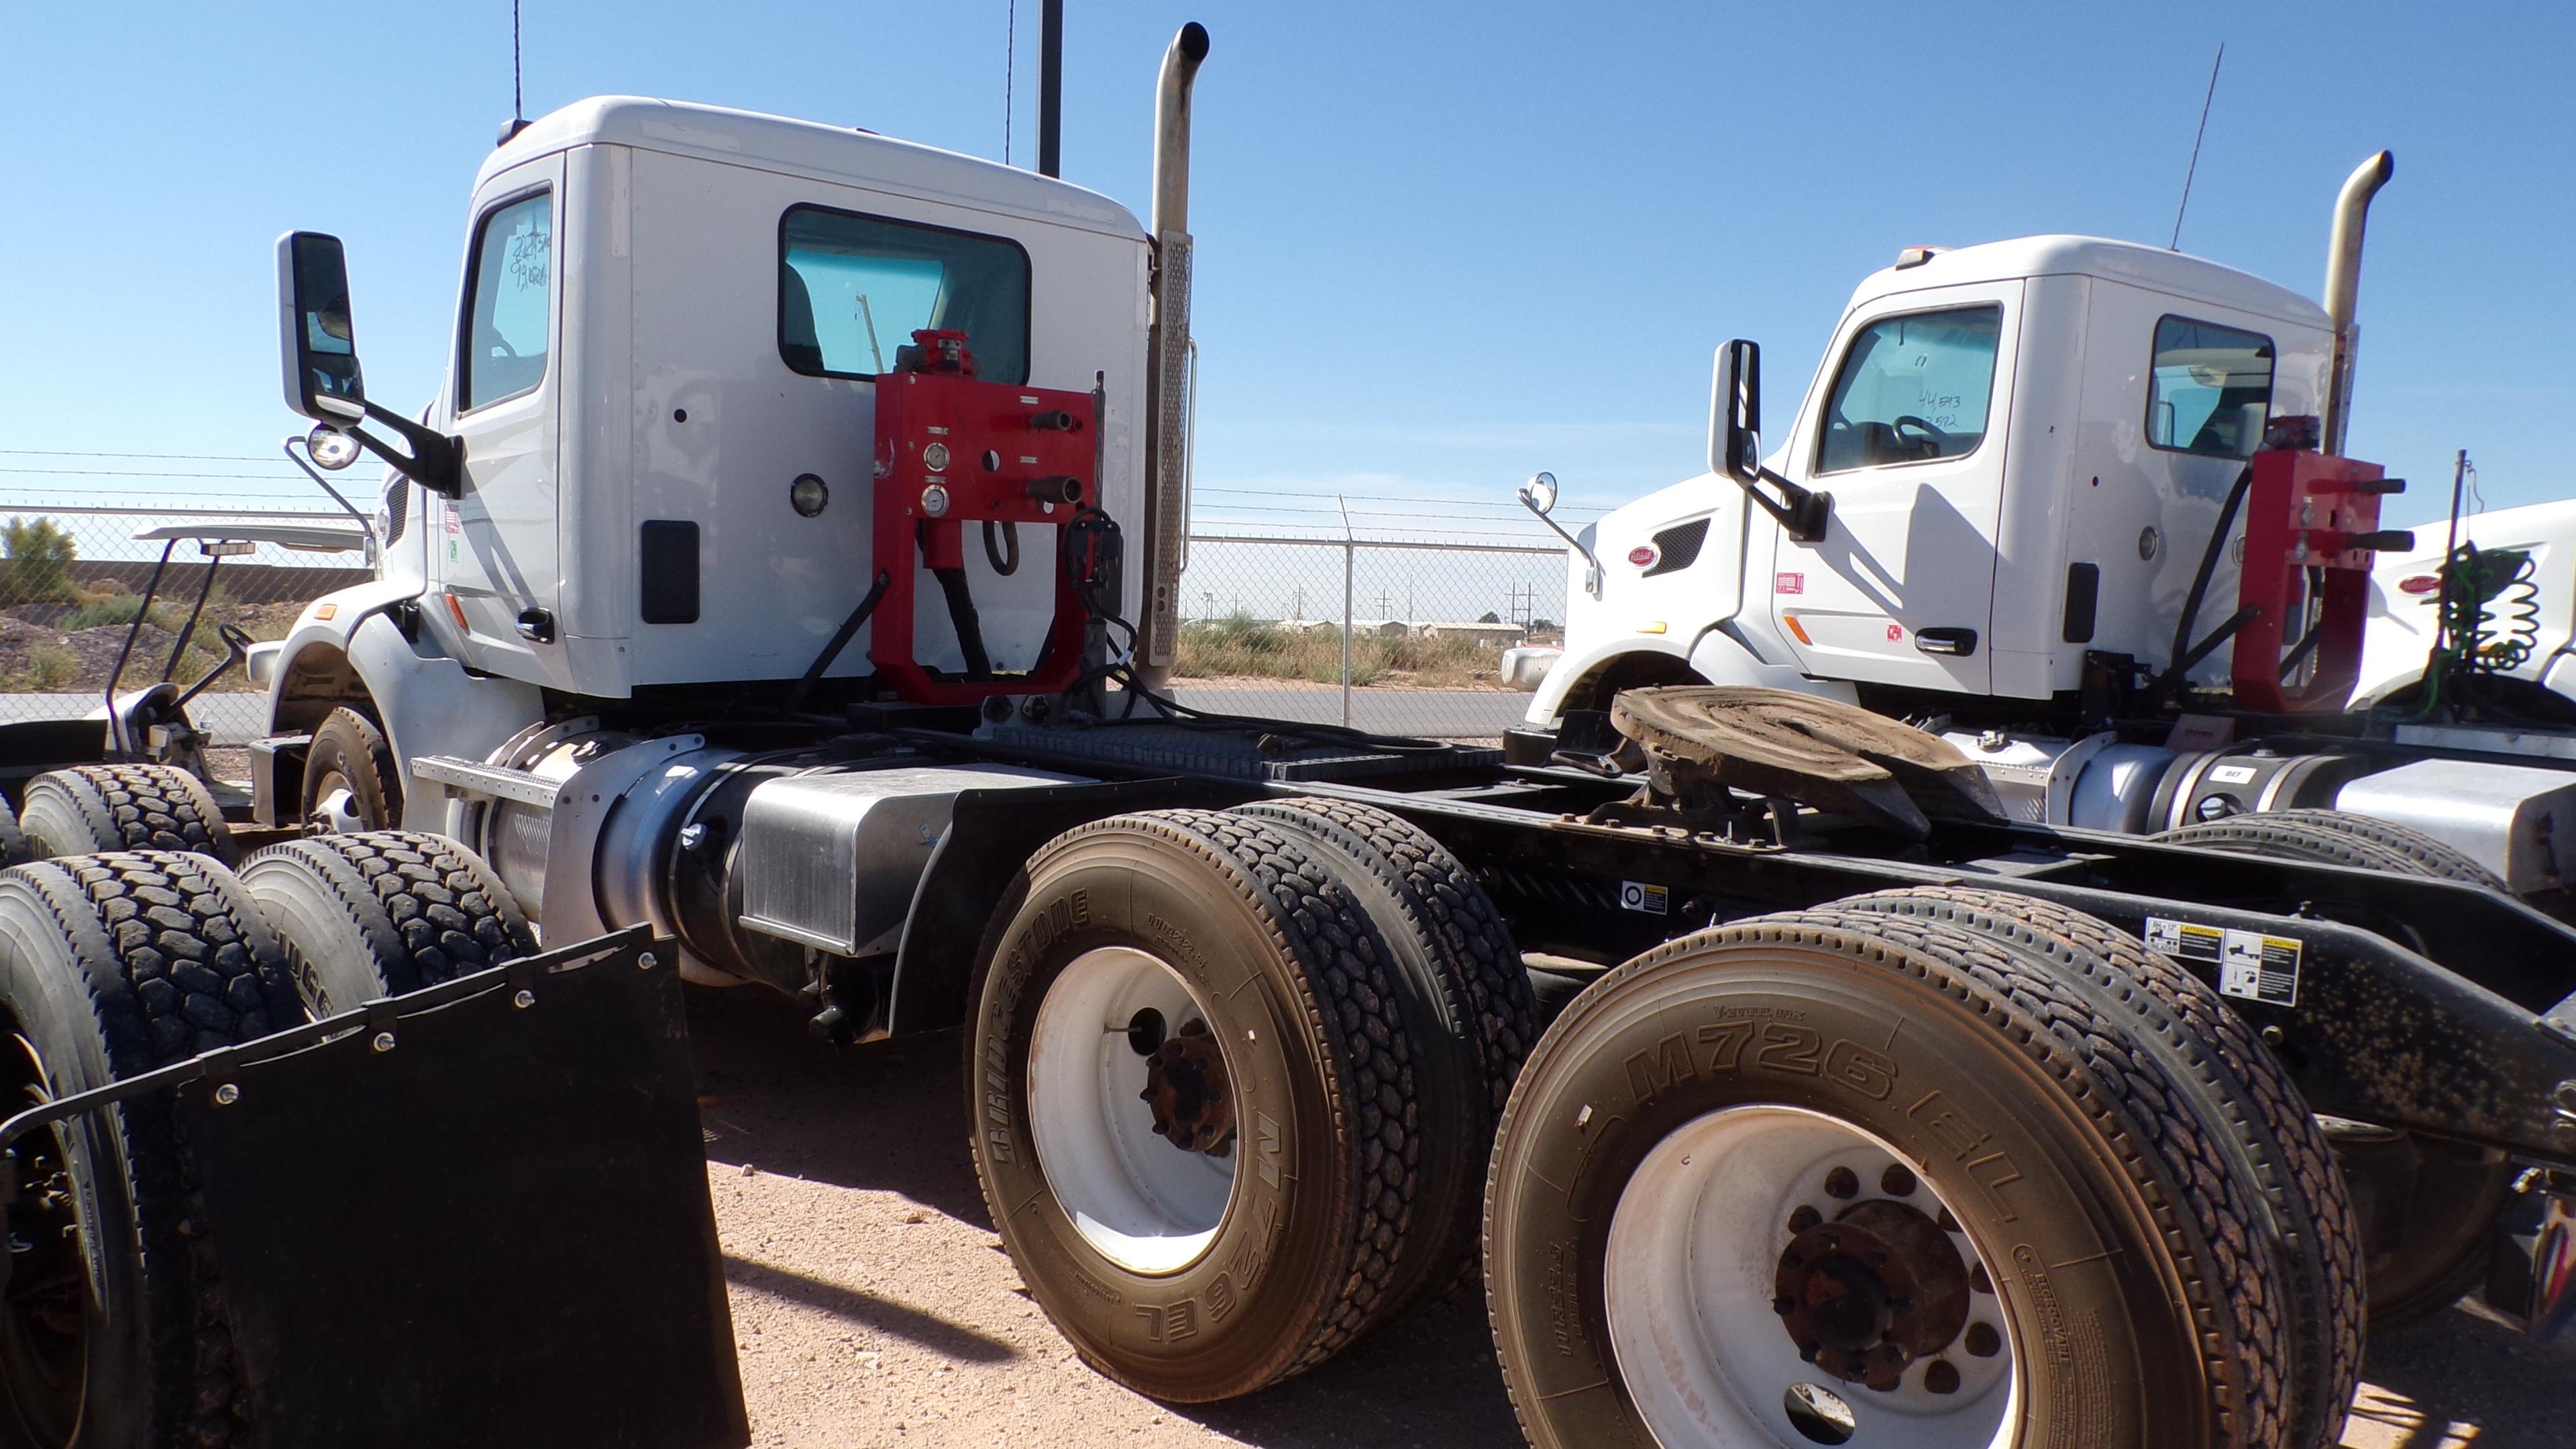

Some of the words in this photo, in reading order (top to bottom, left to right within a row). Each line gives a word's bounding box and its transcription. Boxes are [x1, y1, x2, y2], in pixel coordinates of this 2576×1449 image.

[1919, 390, 1961, 412] 44,593
[2185, 926, 2219, 936] ATTENTION
[2270, 938, 2298, 947] CAUTION
[985, 887, 1091, 1166] BRIDGESTONE
[1622, 1020, 1898, 1106] M726
